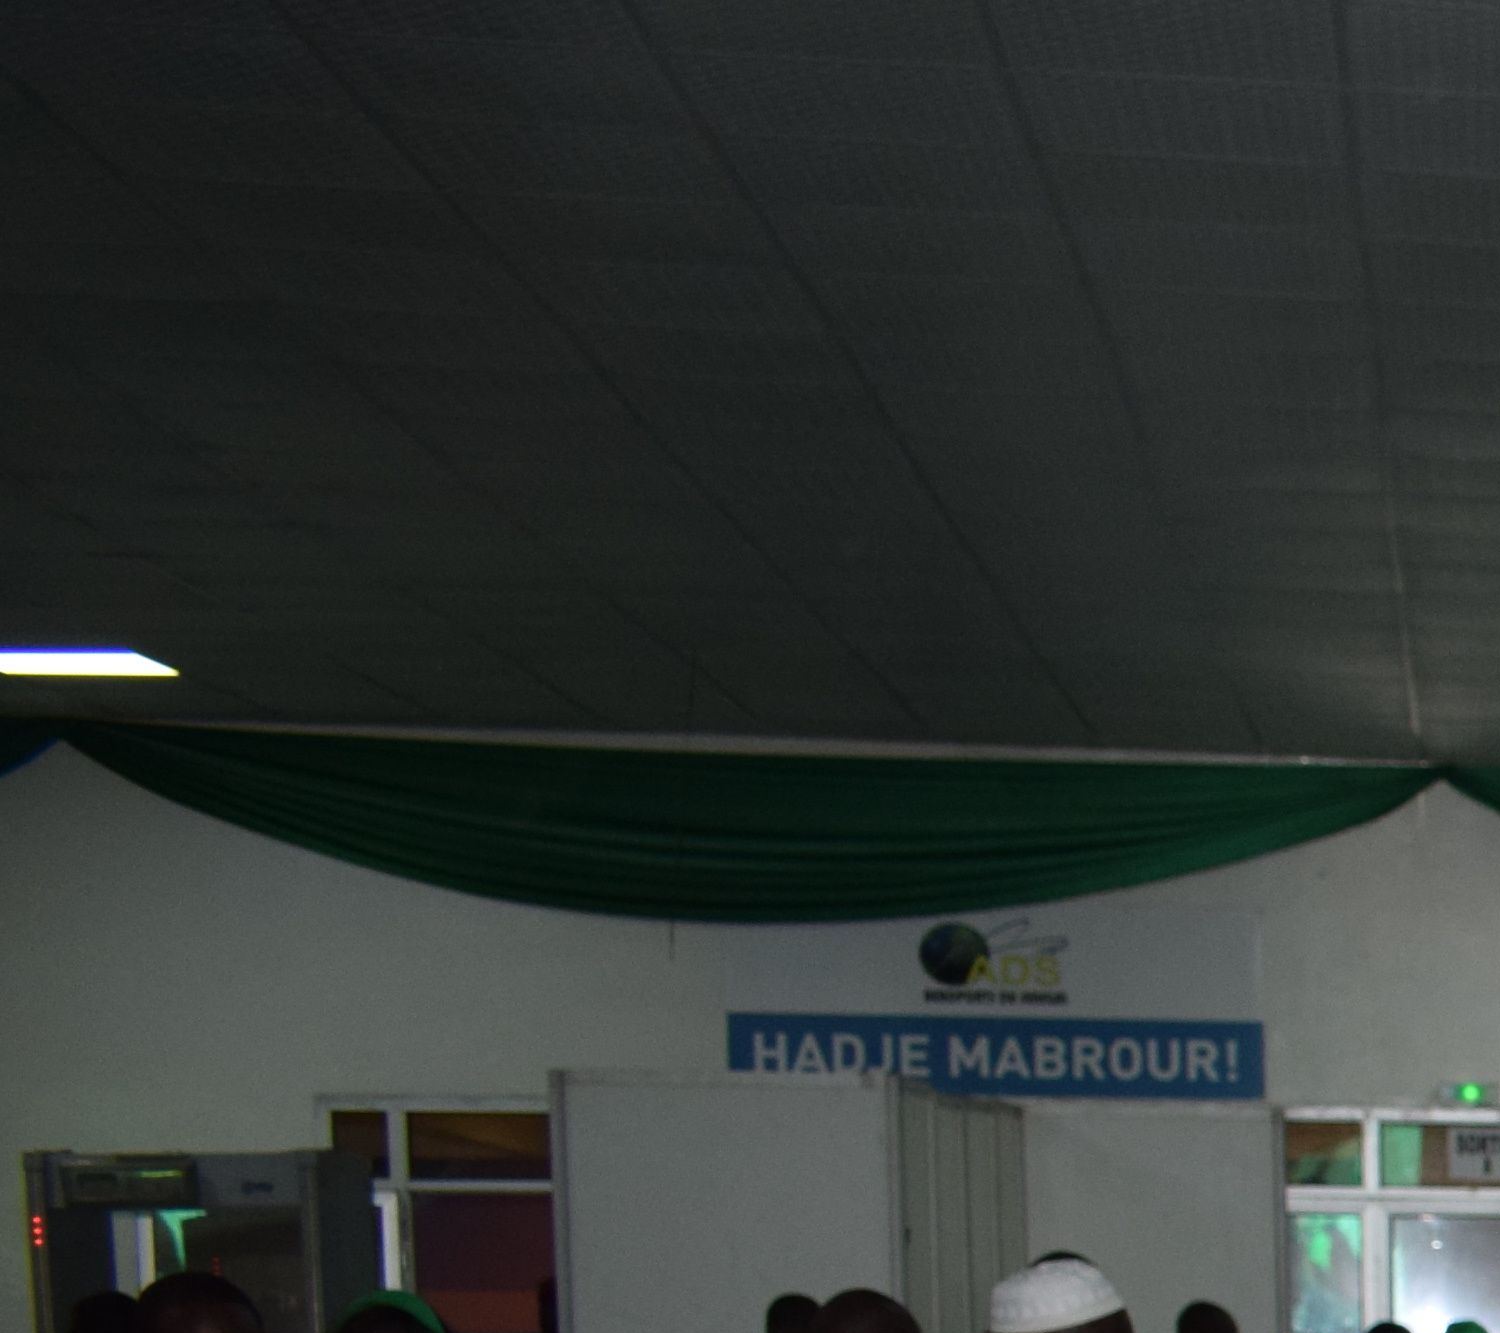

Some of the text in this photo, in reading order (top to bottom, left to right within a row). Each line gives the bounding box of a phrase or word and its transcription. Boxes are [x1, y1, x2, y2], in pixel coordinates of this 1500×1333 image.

[967, 953, 1062, 986] ADS
[753, 1032, 1239, 1082] HADJE MABROUR!
